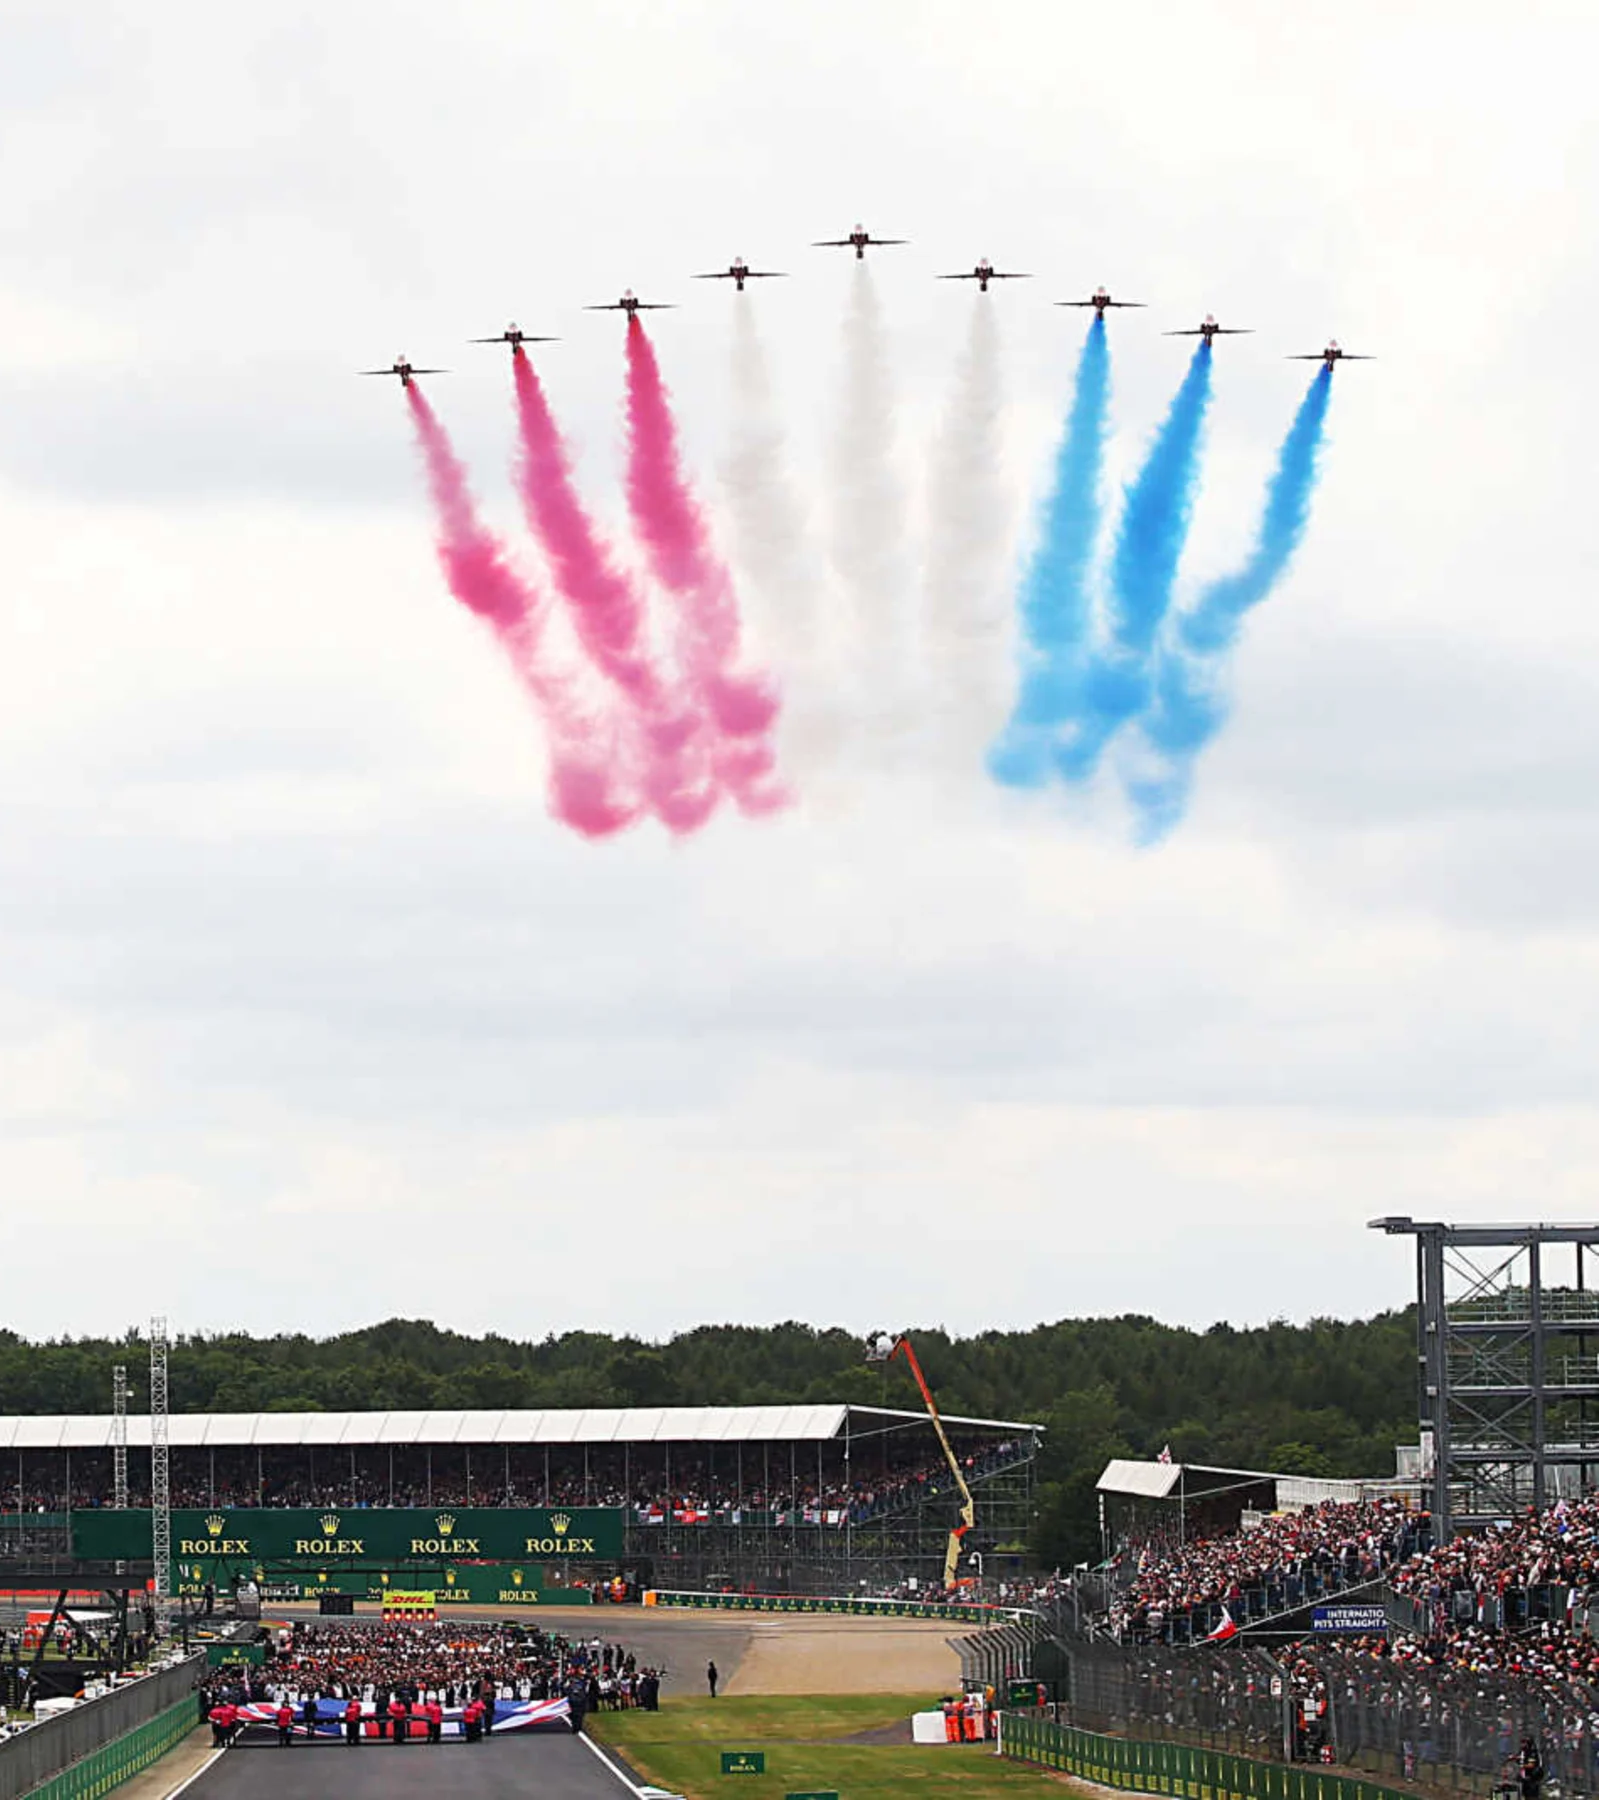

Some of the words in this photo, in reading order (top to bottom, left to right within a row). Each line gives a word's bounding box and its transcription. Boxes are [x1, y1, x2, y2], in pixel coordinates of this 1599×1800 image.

[180, 1540, 249, 1553] ROLEX
[296, 1540, 364, 1553] ROLEX
[411, 1539, 479, 1553] ROLEX
[526, 1538, 595, 1552] ROLEX
[499, 1590, 538, 1601] ROLEX
[1314, 1619, 1333, 1628] PITS
[1335, 1619, 1379, 1628] STRAIGHT
